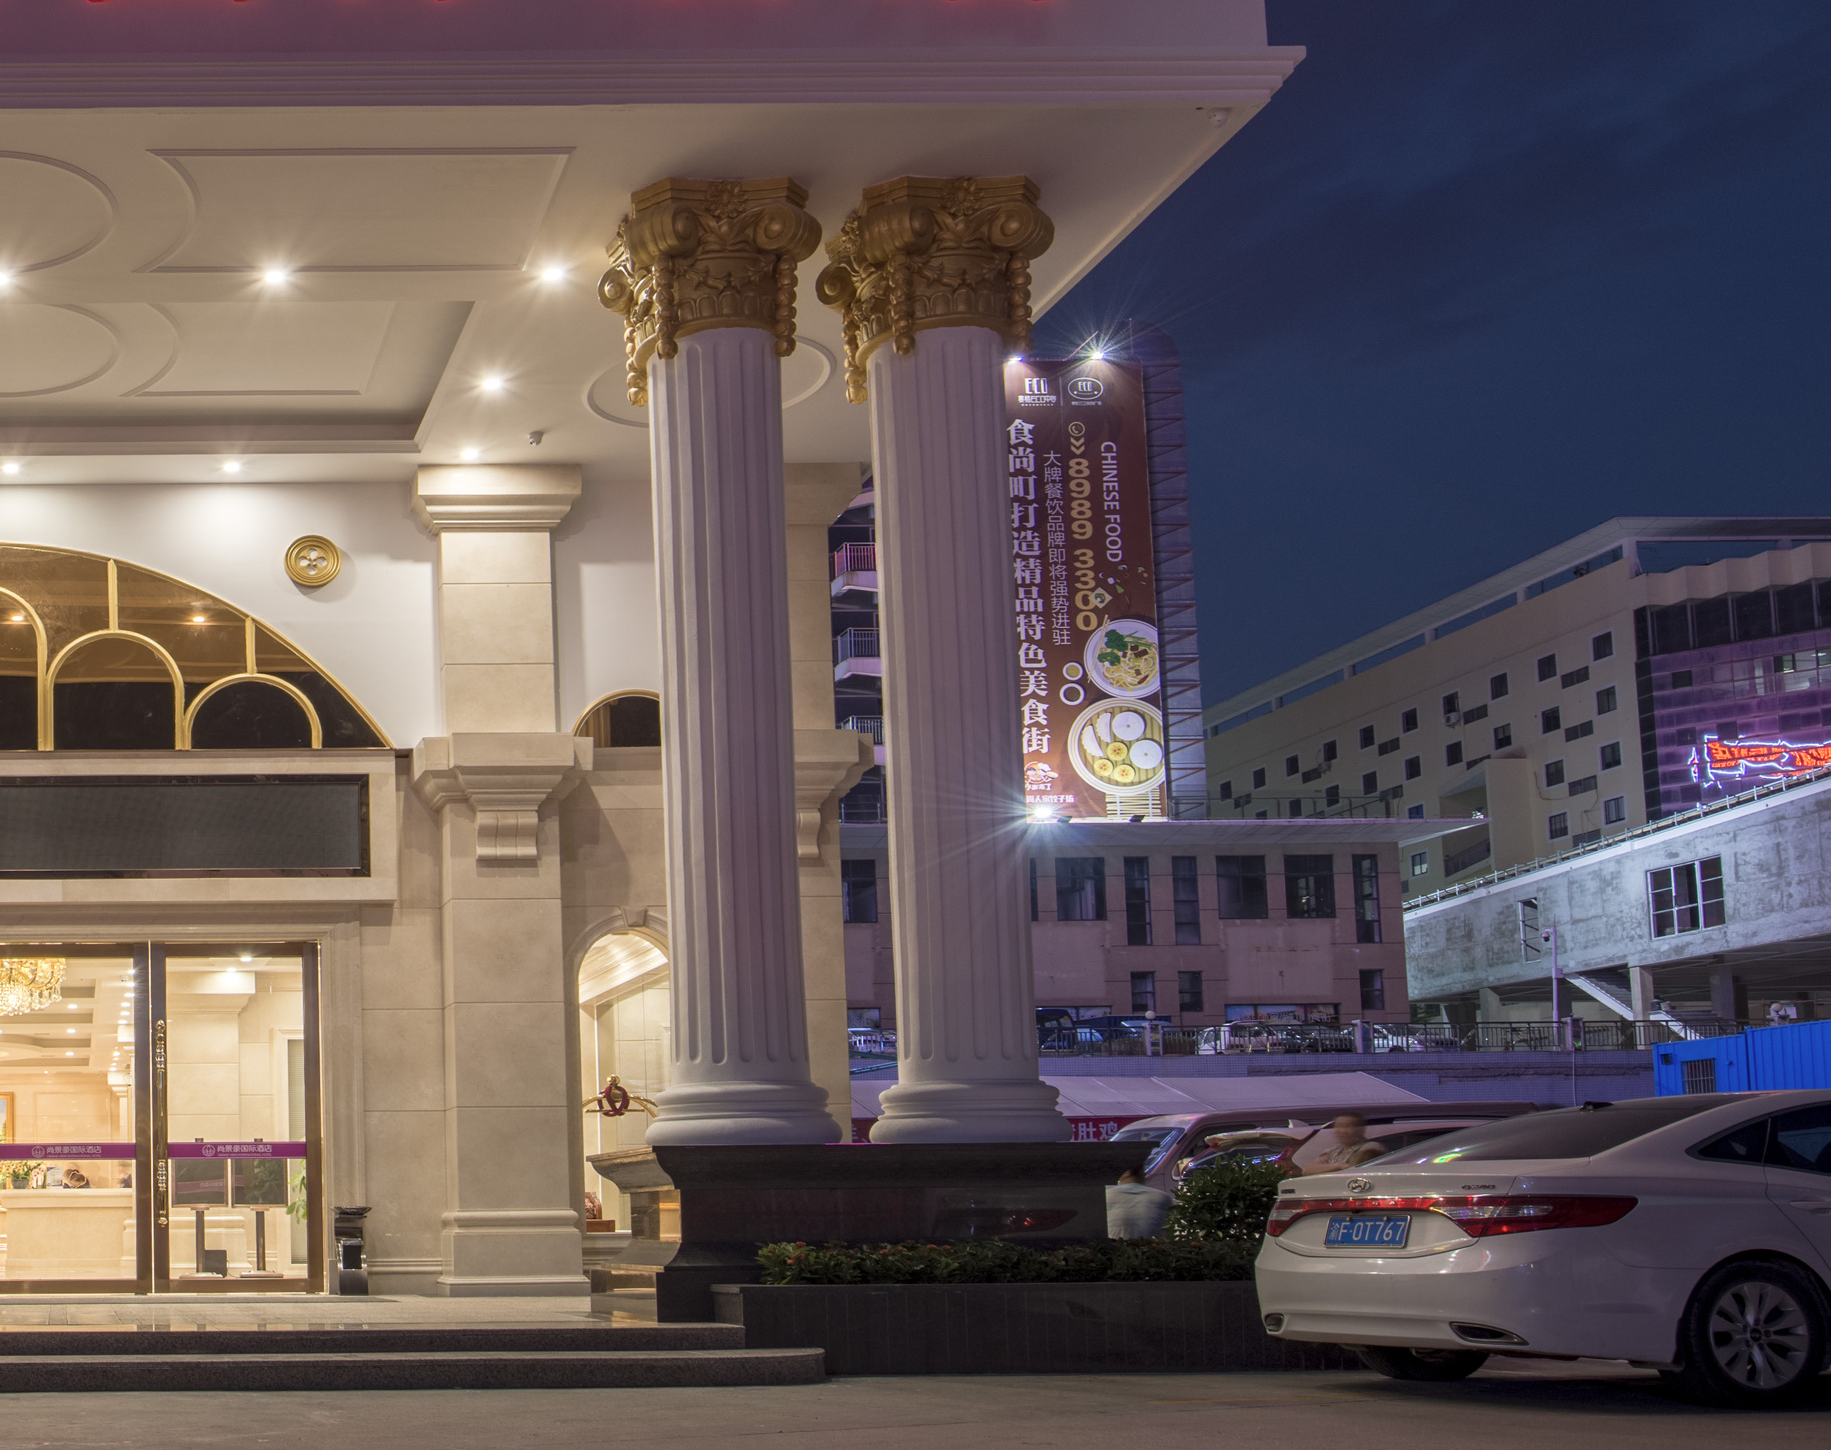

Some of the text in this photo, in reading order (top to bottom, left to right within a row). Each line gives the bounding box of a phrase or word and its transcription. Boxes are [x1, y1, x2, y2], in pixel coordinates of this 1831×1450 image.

[1007, 418, 1051, 754] 食尚町打造精品特色美食街
[1043, 451, 1072, 646] 大牌餐饮品牌即将强势进驻
[1101, 441, 1124, 562] CHINESE FOOD
